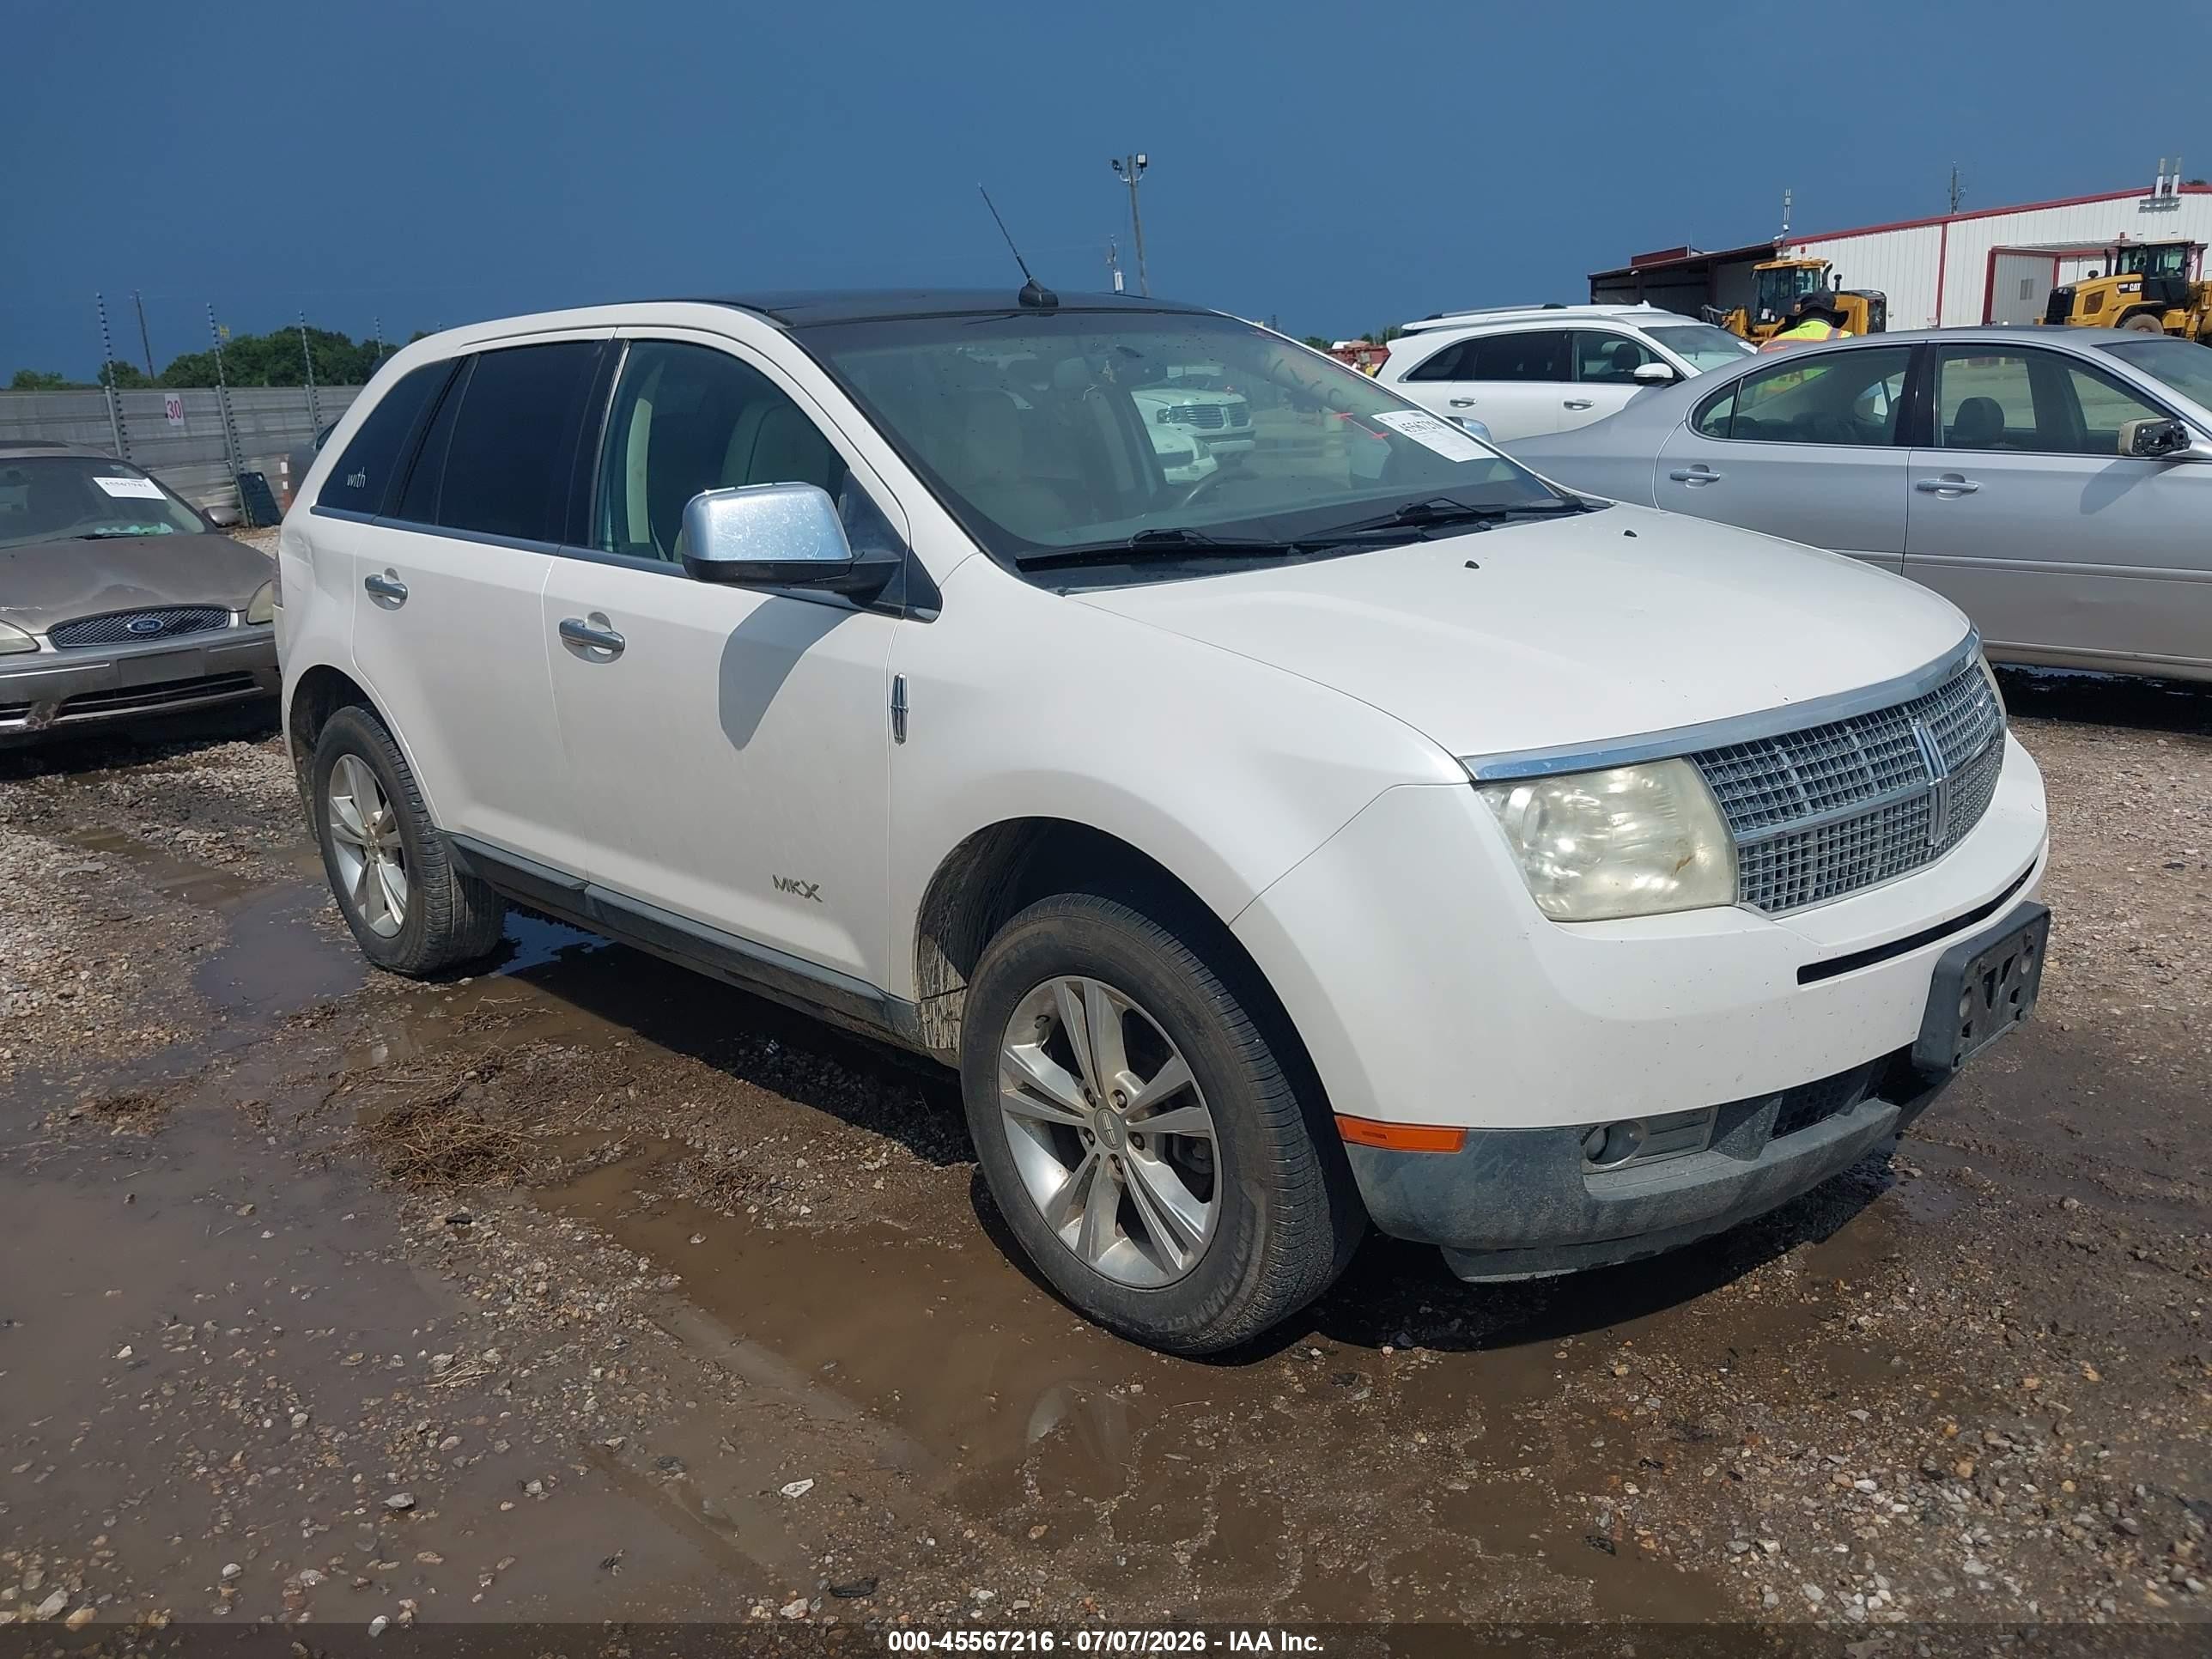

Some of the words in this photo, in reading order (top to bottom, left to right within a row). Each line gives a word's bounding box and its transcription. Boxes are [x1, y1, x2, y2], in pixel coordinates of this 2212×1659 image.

[2129, 283, 2142, 292] CAT
[167, 400, 182, 419] 30
[137, 621, 155, 630] Ford
[772, 873, 823, 902] MKX
